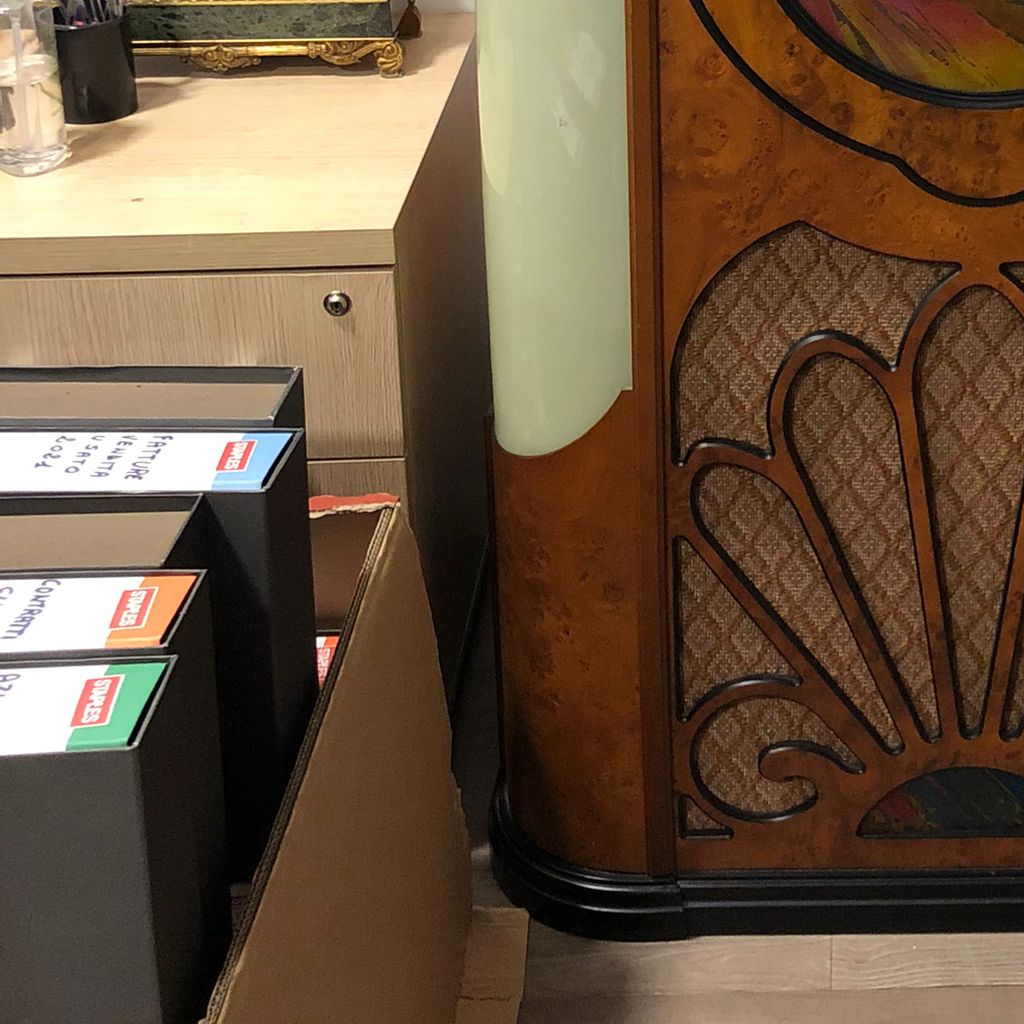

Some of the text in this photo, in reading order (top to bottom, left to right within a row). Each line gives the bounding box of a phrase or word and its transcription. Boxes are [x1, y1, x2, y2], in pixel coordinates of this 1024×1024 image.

[34, 435, 76, 468] 2021
[64, 435, 105, 474] USATO
[90, 435, 138, 477] VENDITA
[124, 435, 174, 480] FATTURE
[223, 441, 248, 470] STAPLES
[1, 579, 62, 639] CONTRATTI
[119, 590, 147, 626] STAPLES
[81, 678, 112, 724] STAPLES
